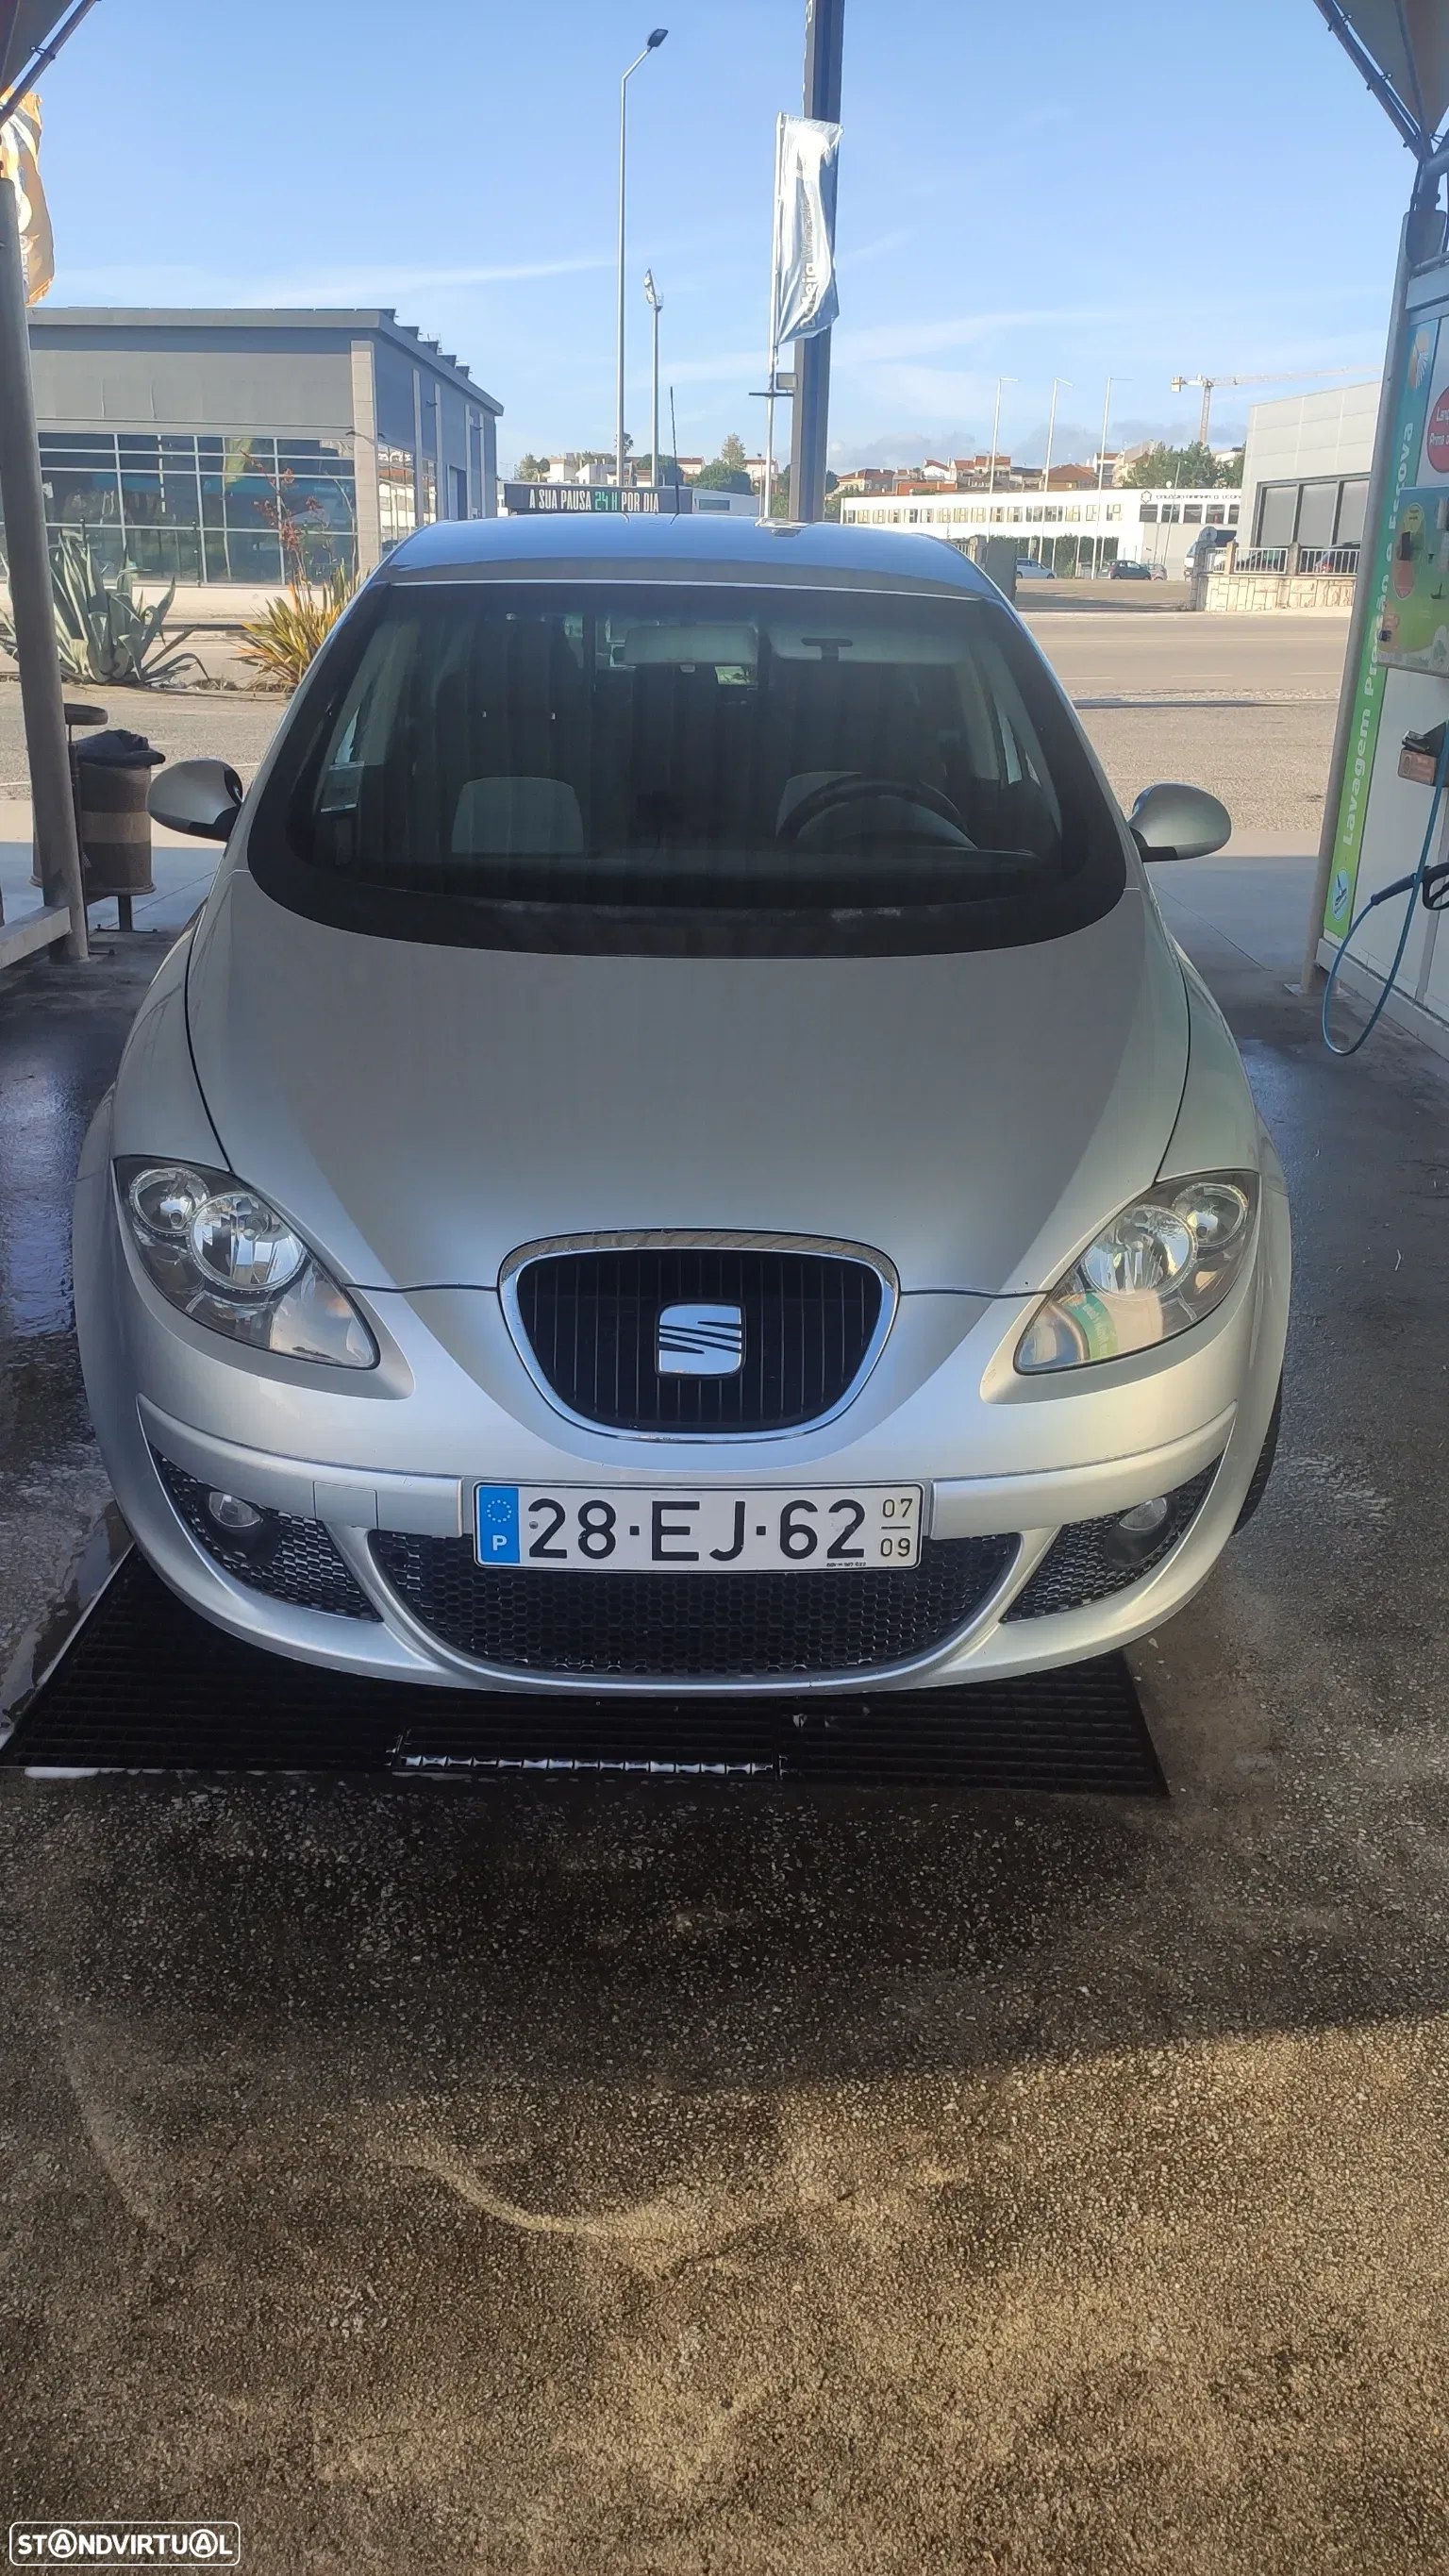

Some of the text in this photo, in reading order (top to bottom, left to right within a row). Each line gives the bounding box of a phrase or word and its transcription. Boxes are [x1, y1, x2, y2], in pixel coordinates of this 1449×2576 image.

[528, 489, 536, 510] A
[539, 490, 558, 510] SUA
[561, 490, 592, 511] PAUSA
[595, 492, 609, 511] 24
[621, 492, 641, 512] POR
[643, 493, 659, 513] DIA
[1343, 709, 1371, 845] Lavagem
[882, 1498, 913, 1518] 07
[492, 1535, 508, 1550] P
[879, 1537, 911, 1558] 09
